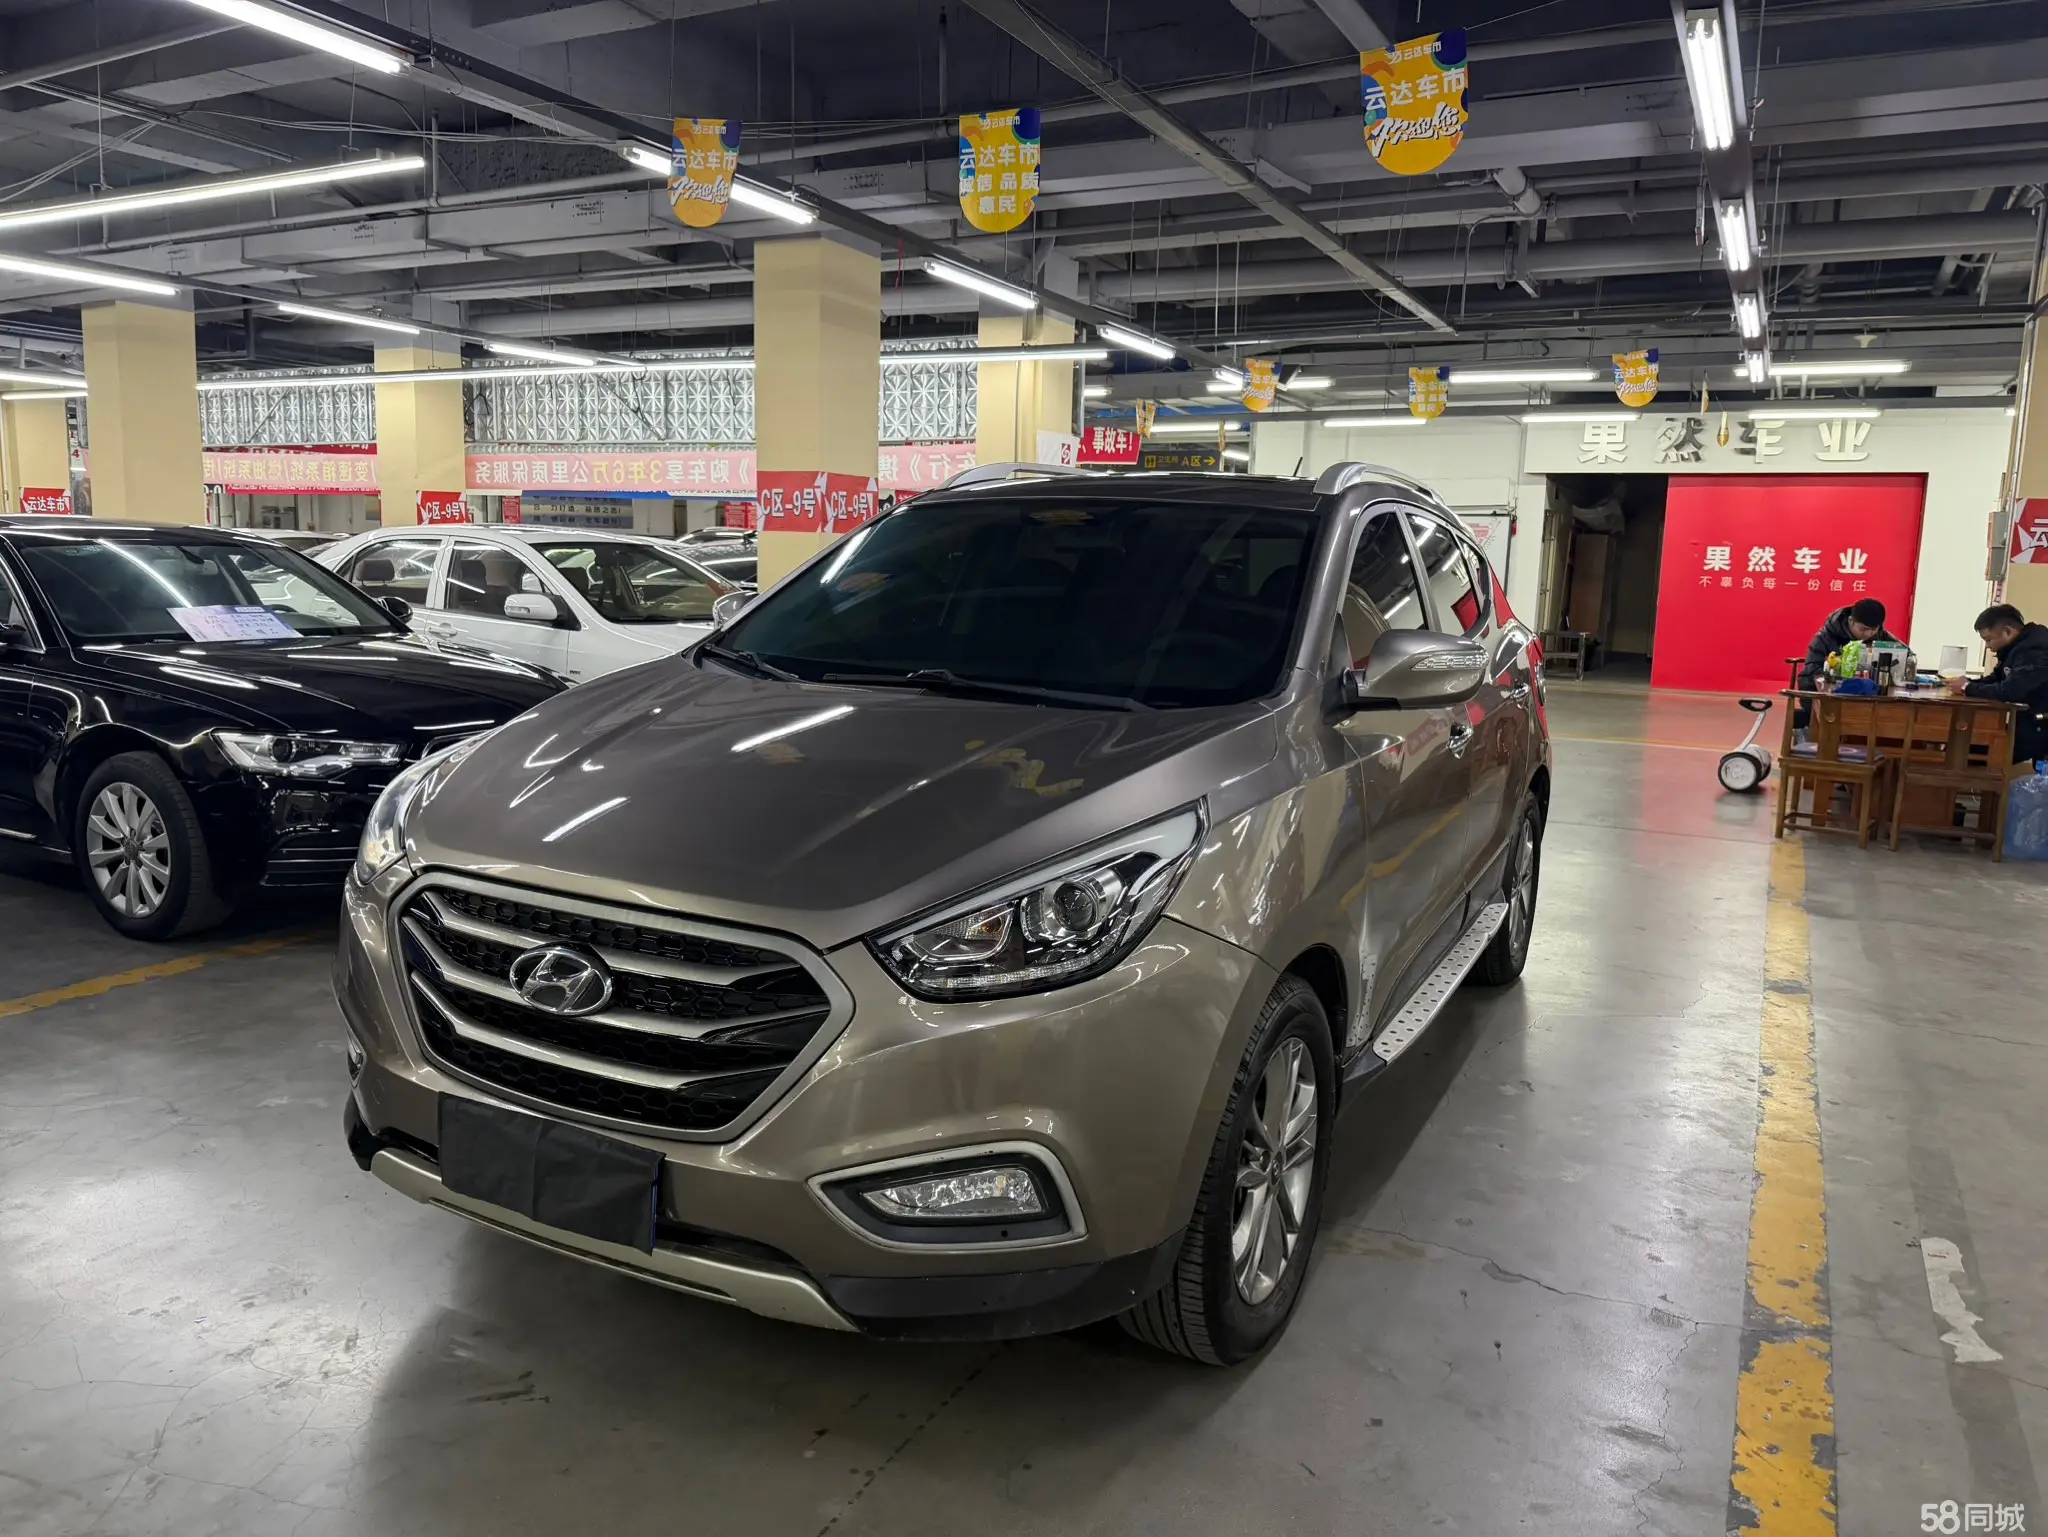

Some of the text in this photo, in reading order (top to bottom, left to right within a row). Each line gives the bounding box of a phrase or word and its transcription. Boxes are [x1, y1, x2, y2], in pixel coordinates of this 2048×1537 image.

[1364, 68, 1466, 111] 云达车市
[672, 149, 737, 171] 云达车市
[960, 143, 1039, 170] 云达车市
[1577, 416, 1872, 464] 果然车业
[28, 496, 66, 512] 云达车市
[425, 501, 461, 521] C区-9号
[760, 488, 816, 519] C区-9号
[831, 492, 869, 521] C区-9号
[1703, 546, 1868, 575] 果然车业
[1699, 576, 1868, 592] 不辜负每一份信任
